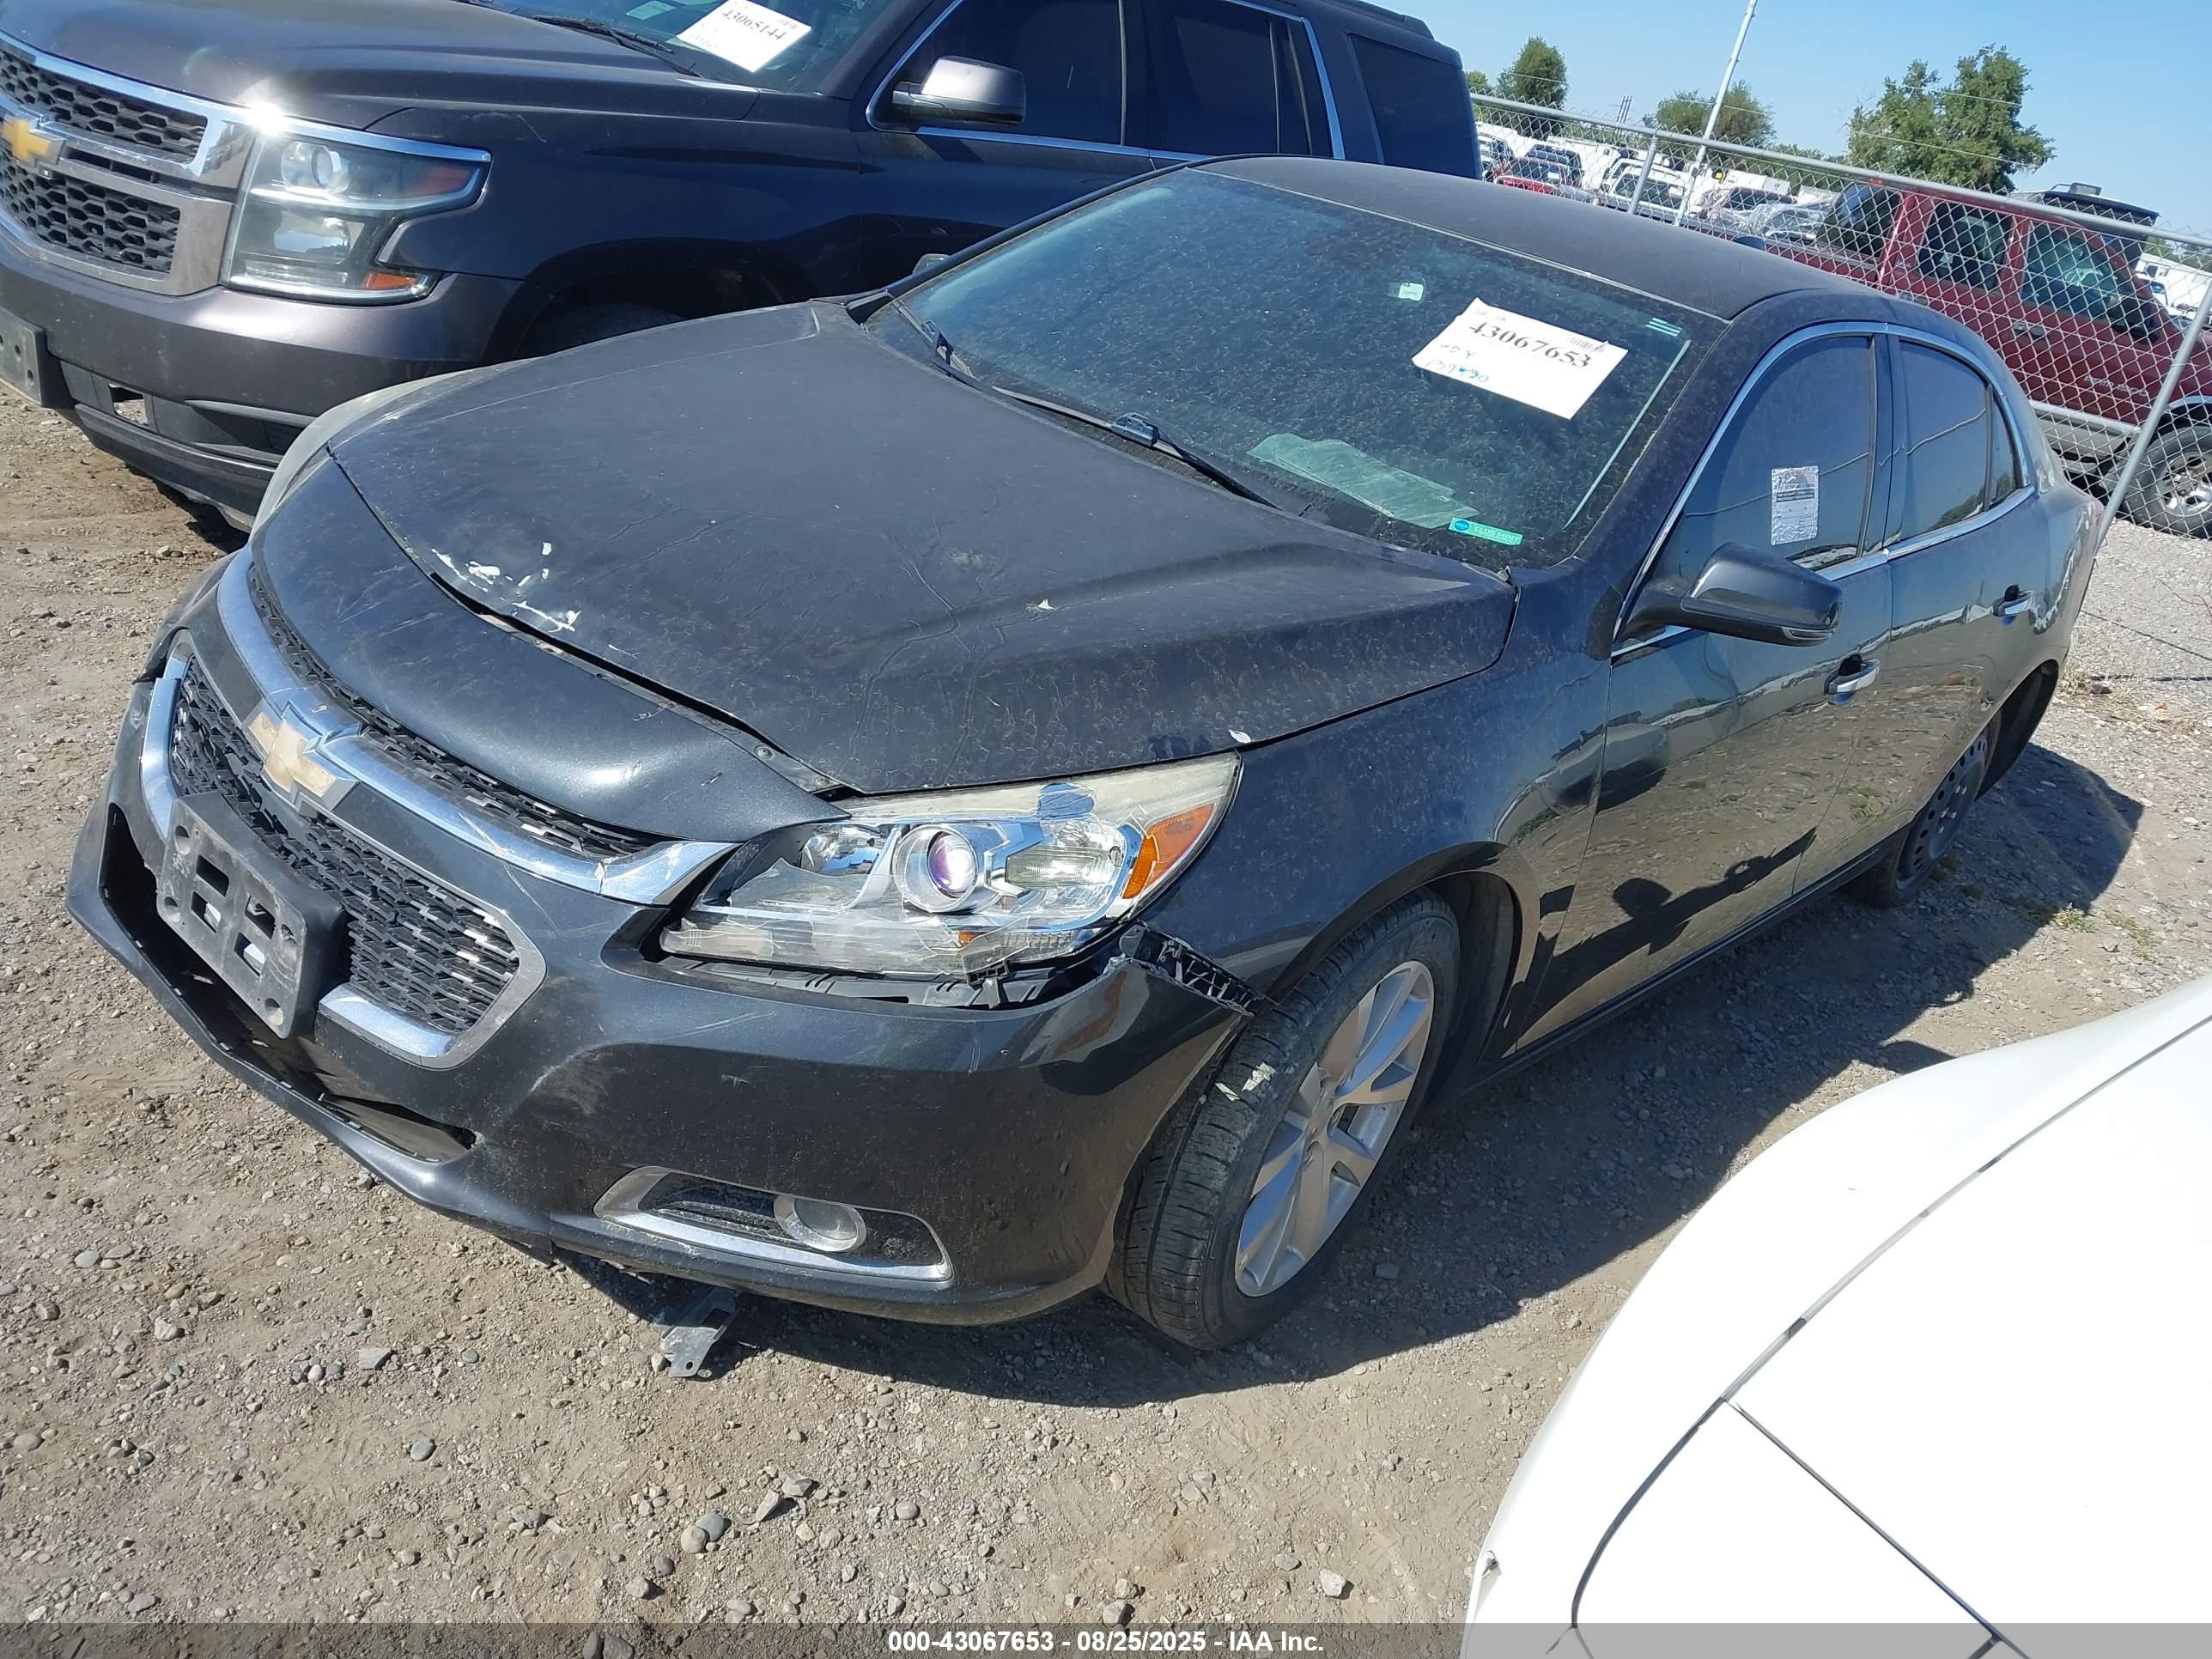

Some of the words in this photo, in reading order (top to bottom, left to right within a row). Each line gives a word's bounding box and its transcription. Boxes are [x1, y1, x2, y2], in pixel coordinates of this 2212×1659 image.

[722, 9, 787, 40] 43065144
[1468, 321, 1592, 368] 43067653
[1497, 532, 1519, 543] MINT
